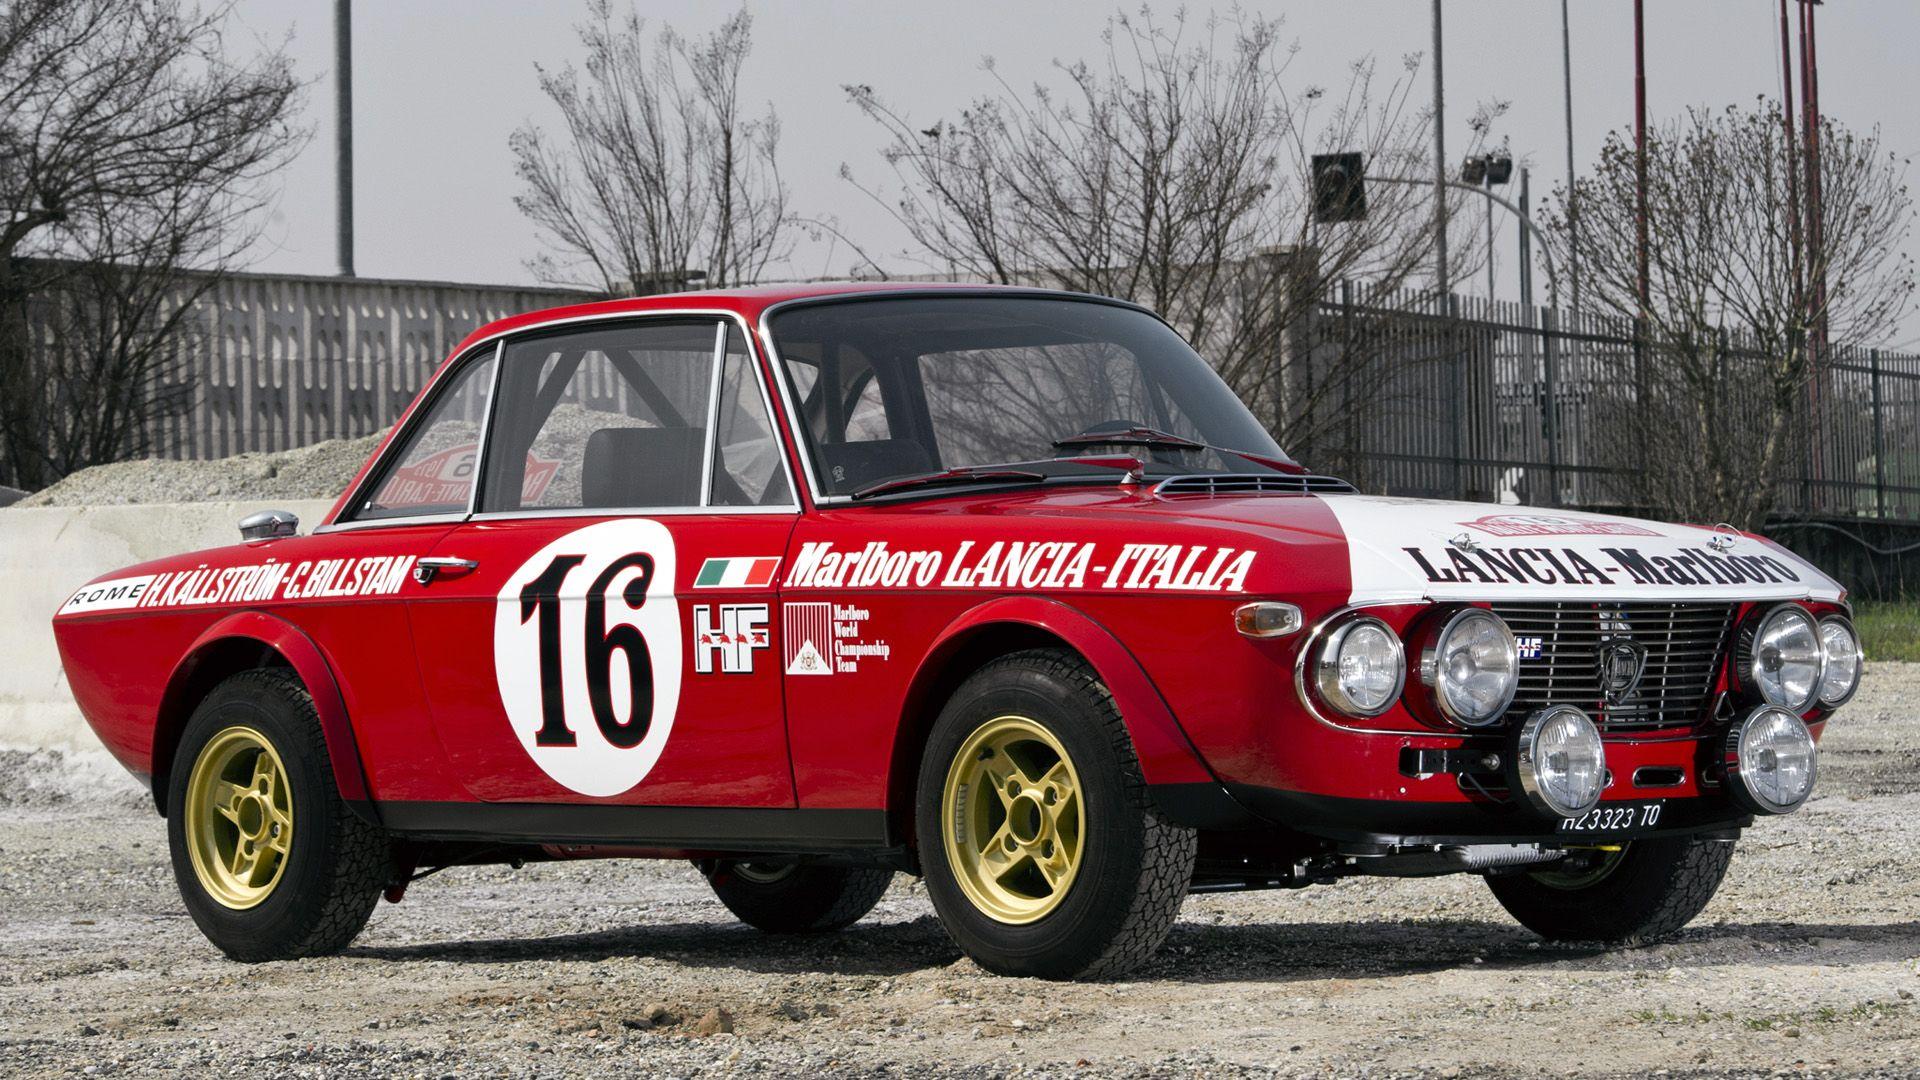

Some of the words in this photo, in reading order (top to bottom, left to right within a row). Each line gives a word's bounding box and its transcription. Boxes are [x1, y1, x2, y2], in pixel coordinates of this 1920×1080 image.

[783, 541, 943, 588] Marlboro
[69, 584, 146, 606] ROME
[833, 604, 869, 621] Marlboro
[693, 603, 770, 674] HF
[834, 622, 858, 638] World
[519, 552, 655, 749] 16
[835, 640, 890, 661] Championship
[1516, 637, 1542, 658] HF
[836, 656, 857, 673] Team
[1641, 804, 1660, 826] TO
